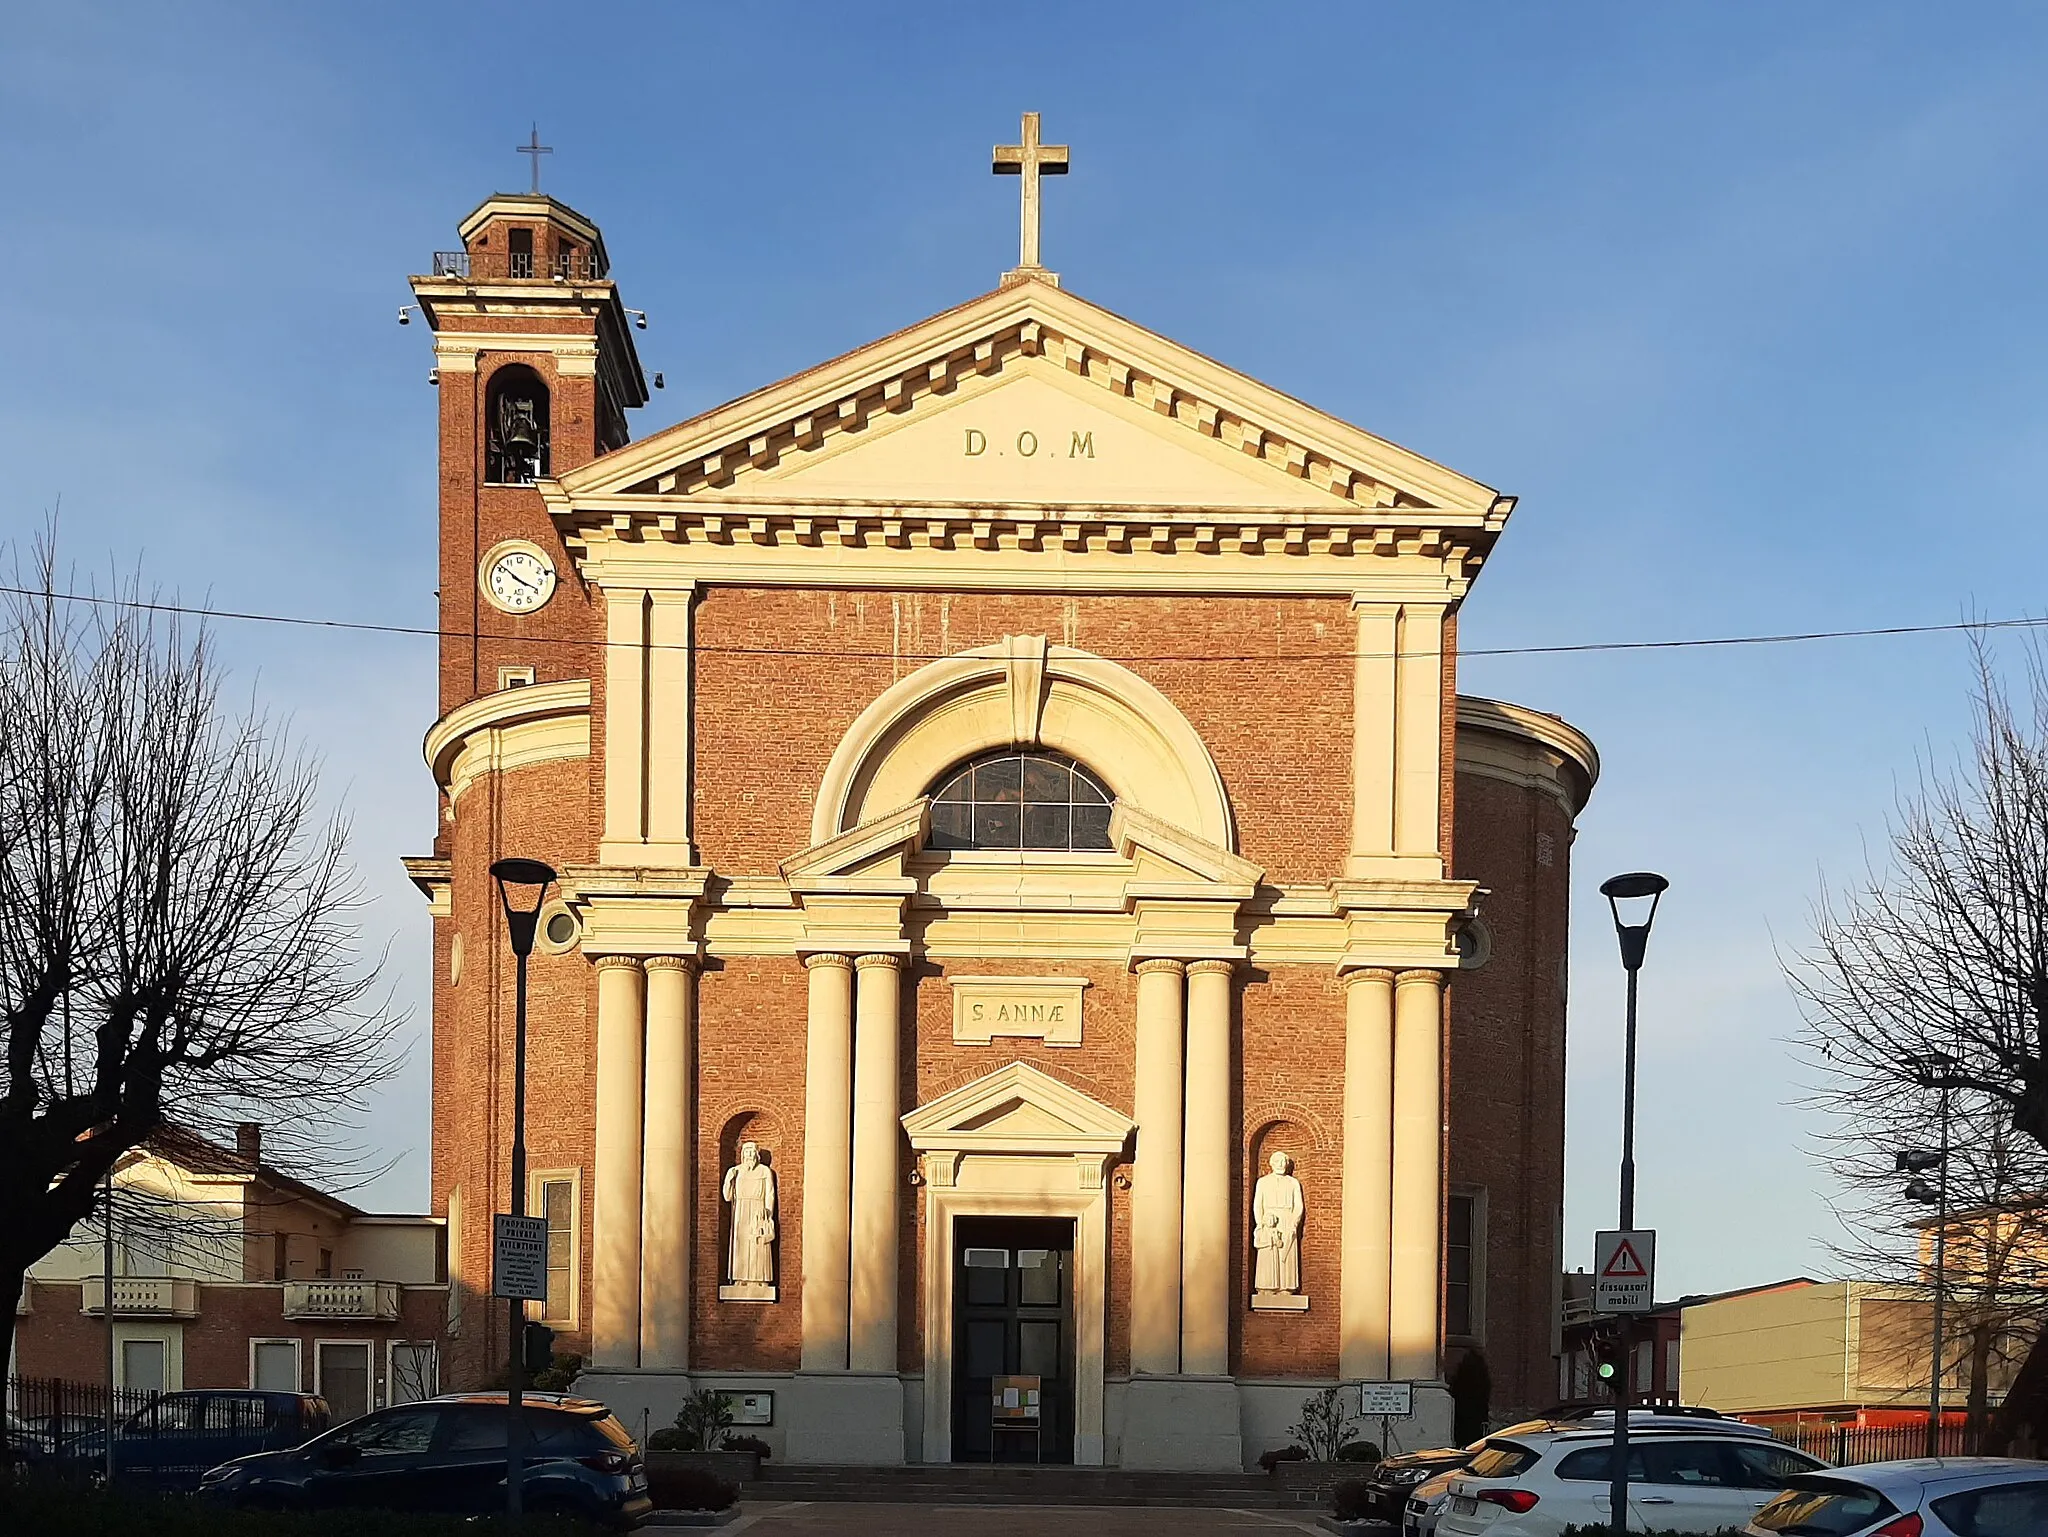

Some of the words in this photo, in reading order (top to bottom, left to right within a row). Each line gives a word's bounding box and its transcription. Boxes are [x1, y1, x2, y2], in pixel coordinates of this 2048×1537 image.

[506, 559, 513, 567] 11
[535, 567, 541, 575] 2
[537, 578, 543, 586] 3
[506, 1228, 537, 1239] PRIVATA
[499, 1240, 542, 1251] ATTENZIONE
[1599, 1281, 1648, 1292] dissuasori
[1608, 1295, 1639, 1305] mobili
